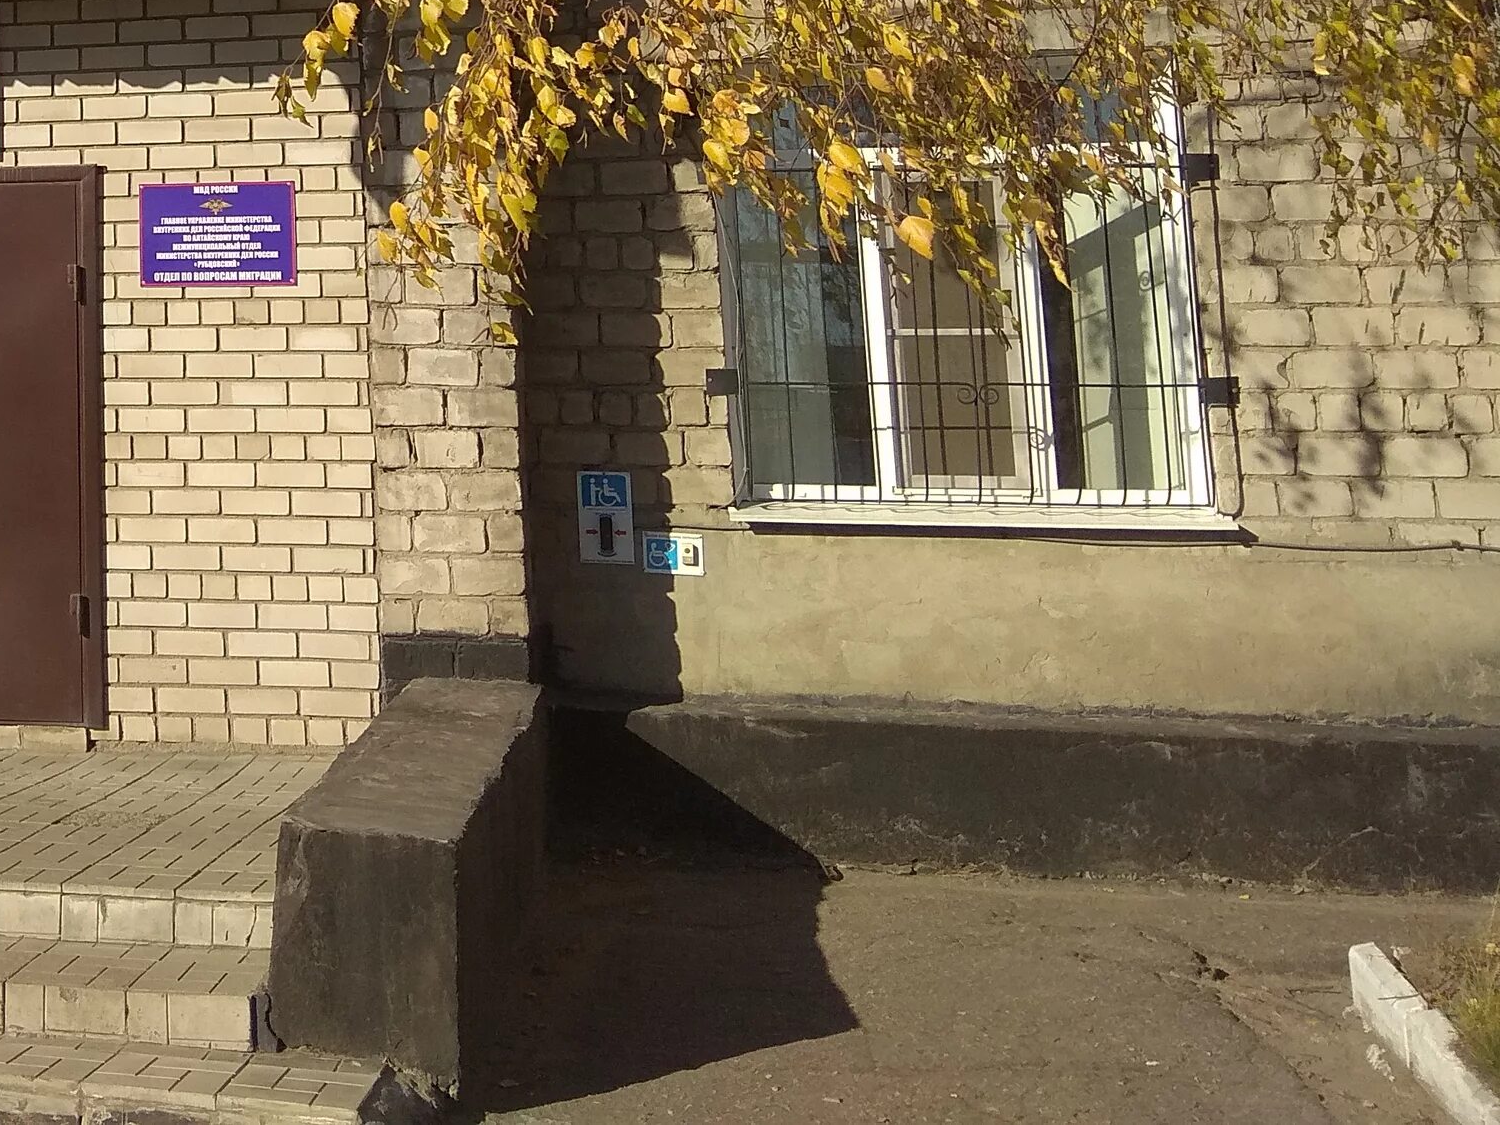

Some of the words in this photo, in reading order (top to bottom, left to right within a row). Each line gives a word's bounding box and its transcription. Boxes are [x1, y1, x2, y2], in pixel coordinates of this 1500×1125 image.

[193, 186, 210, 195] МВД
[211, 185, 239, 194] РОССИИ
[154, 272, 181, 282] ОТДЕЛ
[181, 272, 192, 281] ПО
[193, 271, 238, 281] ВОПРОСАМ
[238, 271, 282, 281] МИГРАЦИИ
